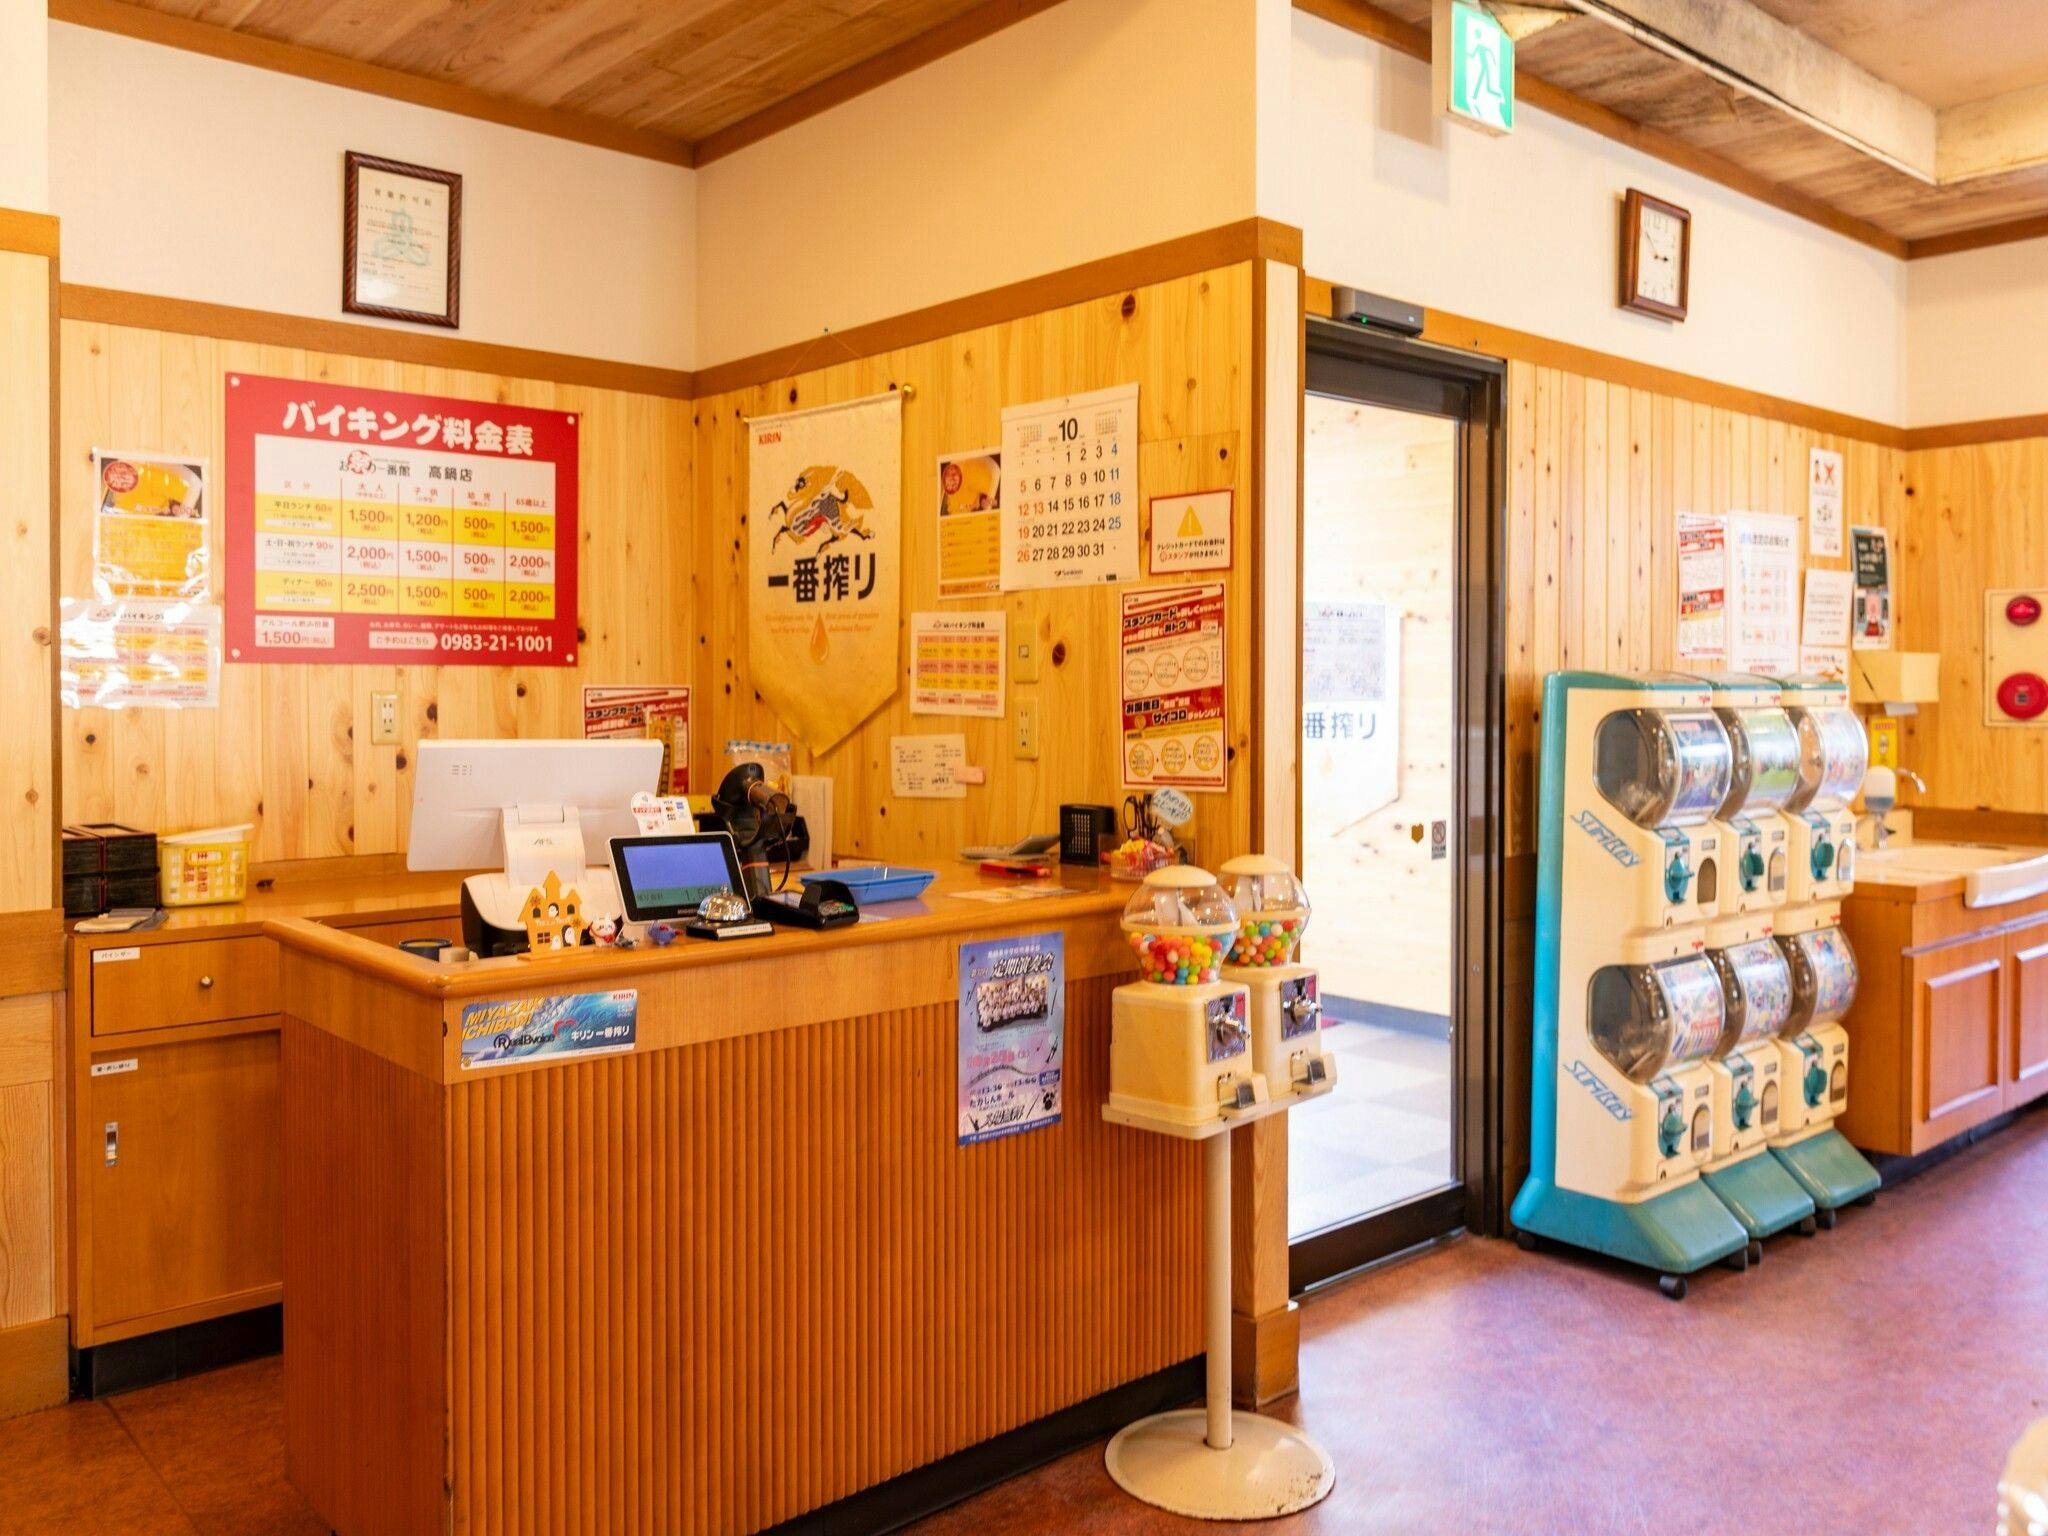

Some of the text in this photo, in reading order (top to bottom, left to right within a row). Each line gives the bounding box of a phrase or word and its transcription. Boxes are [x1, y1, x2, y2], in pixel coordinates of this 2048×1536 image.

[282, 401, 534, 456] バイキング料金表
[1059, 418, 1078, 442] 10
[758, 431, 782, 446] KIRIN
[1066, 443, 1118, 462] 1 2 3 4
[429, 465, 472, 482] 高鍋店
[1020, 467, 1120, 493] 5 6 7 8 9 10 11
[1018, 492, 1121, 516] 12 13 14 15 16 17 18
[349, 509, 393, 523] 1,500円
[406, 513, 448, 527] 1,200円
[464, 517, 495, 530] 500円
[511, 520, 550, 533] 1,500円
[1018, 517, 1121, 539] 19 20 21 22 23 24 25
[347, 546, 394, 560] 2,000円
[406, 549, 448, 563] 1,500円
[464, 553, 496, 565] 500円
[1017, 543, 1105, 562] 26 27 28 29 30 31
[510, 555, 550, 569] 2,000円
[768, 553, 876, 602] 一番搾り
[347, 584, 394, 597] 2,500円
[406, 585, 448, 598] 1,500円
[464, 588, 496, 600] 500円
[510, 590, 550, 603] 2,000円
[375, 635, 429, 646] ご予約はこちら
[440, 633, 553, 652] 0983-21-1001
[612, 991, 635, 1000] KIRIN
